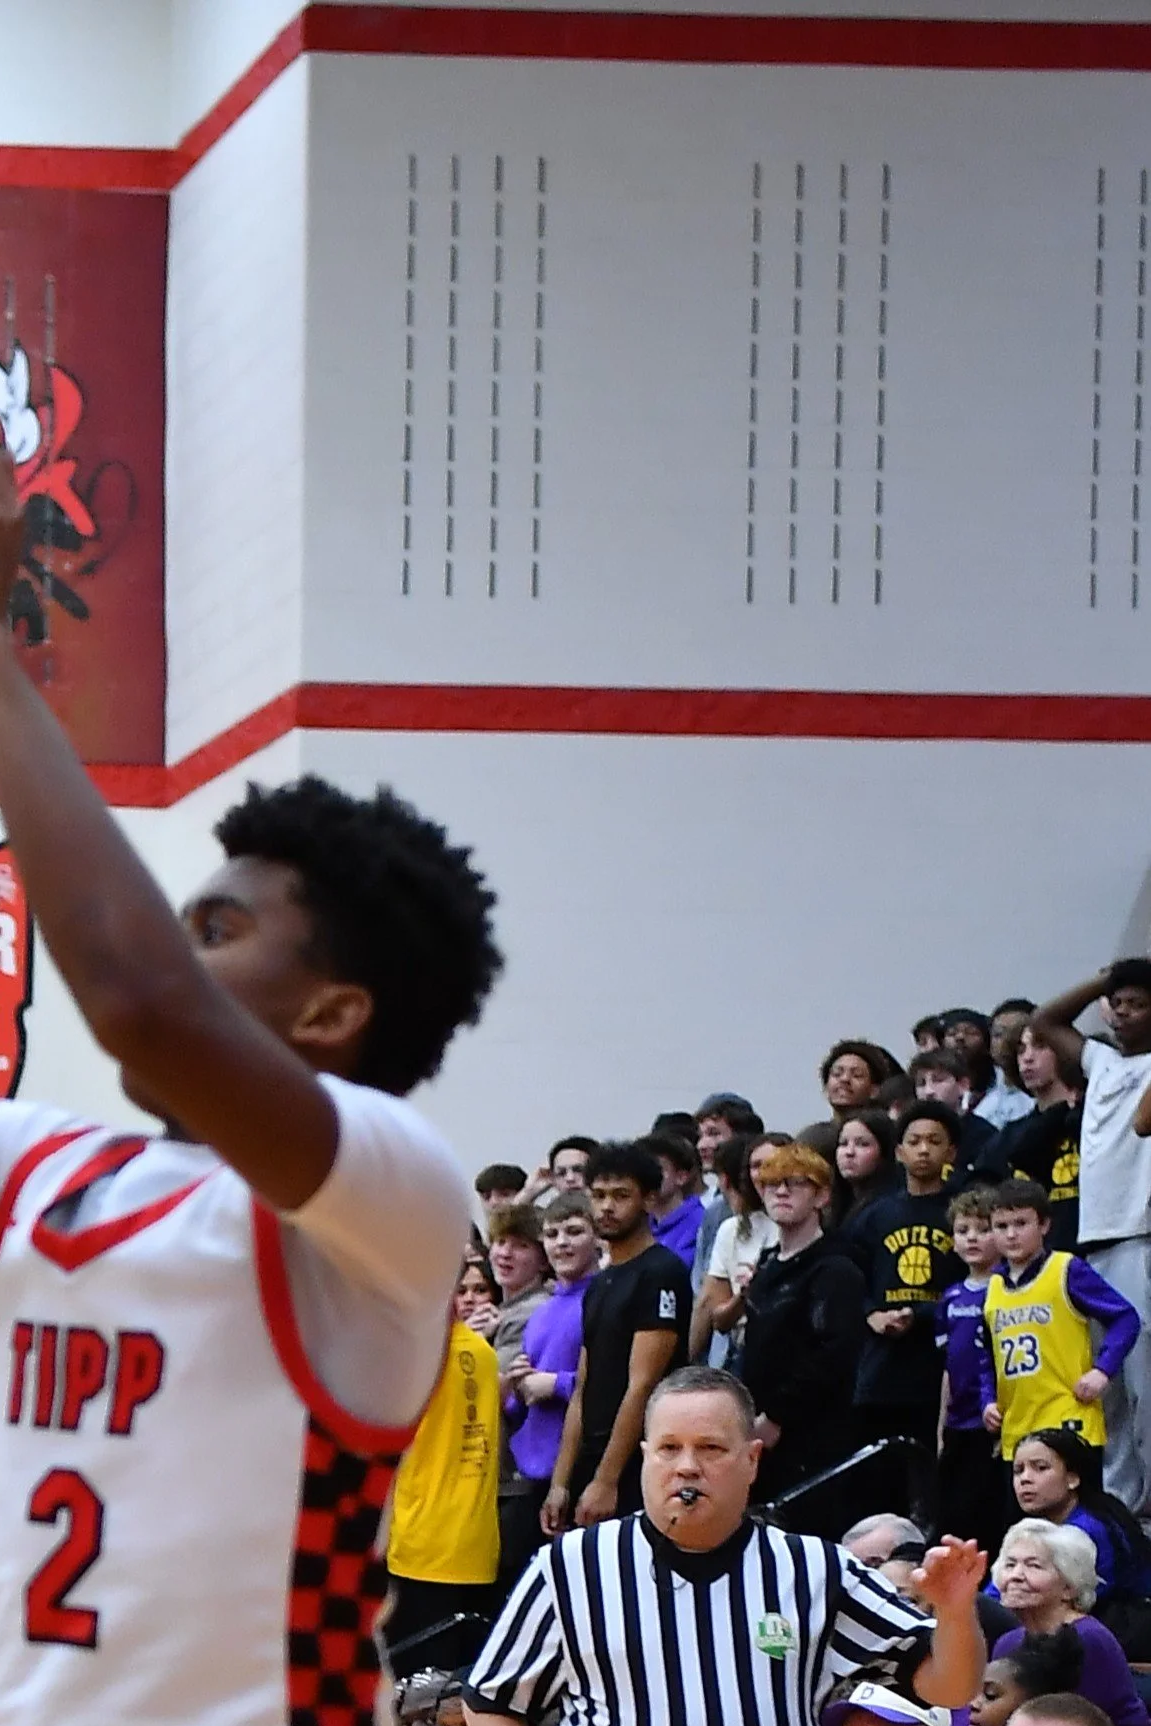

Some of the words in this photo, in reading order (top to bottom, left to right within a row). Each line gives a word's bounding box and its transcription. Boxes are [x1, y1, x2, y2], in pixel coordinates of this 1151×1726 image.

[7, 1321, 166, 1435] TIPP
[1001, 1333, 1040, 1379] 23
[25, 1467, 105, 1651] 2
